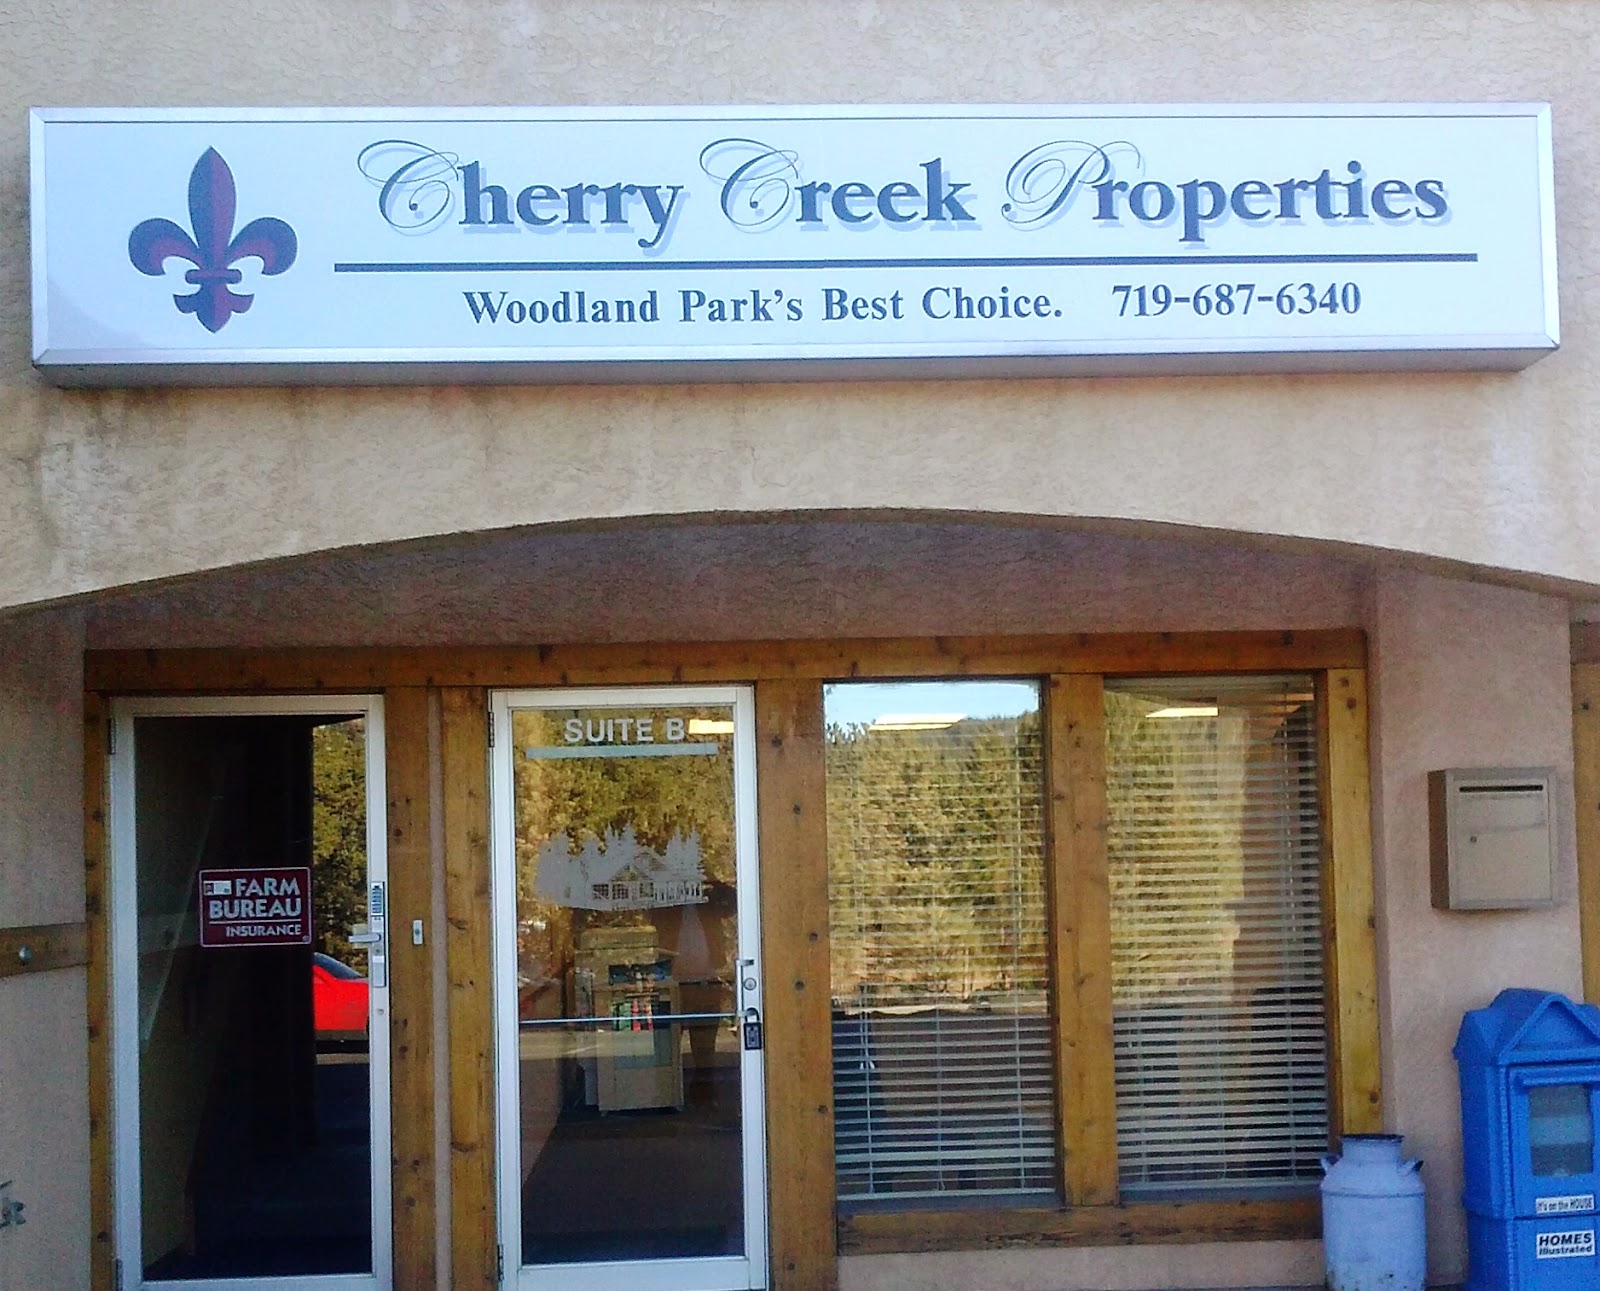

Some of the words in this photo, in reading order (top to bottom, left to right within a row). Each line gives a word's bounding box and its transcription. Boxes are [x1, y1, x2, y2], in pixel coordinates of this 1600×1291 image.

[357, 138, 685, 252] Cherry
[699, 137, 977, 228] Creek
[1000, 139, 1450, 244] Properties
[463, 289, 659, 325] Woodland
[679, 288, 803, 323] Park's
[821, 287, 903, 321] Best
[922, 286, 1063, 320] Choice.
[1111, 281, 1363, 318] 719-687-6340
[564, 718, 654, 743] SUITE
[666, 717, 685, 741] B
[235, 877, 300, 897] FARM
[209, 898, 301, 919] BUREAU
[226, 924, 302, 937] INSURANCE
[1539, 1233, 1592, 1246] HOMES
[1539, 1244, 1592, 1255] Illustrated
